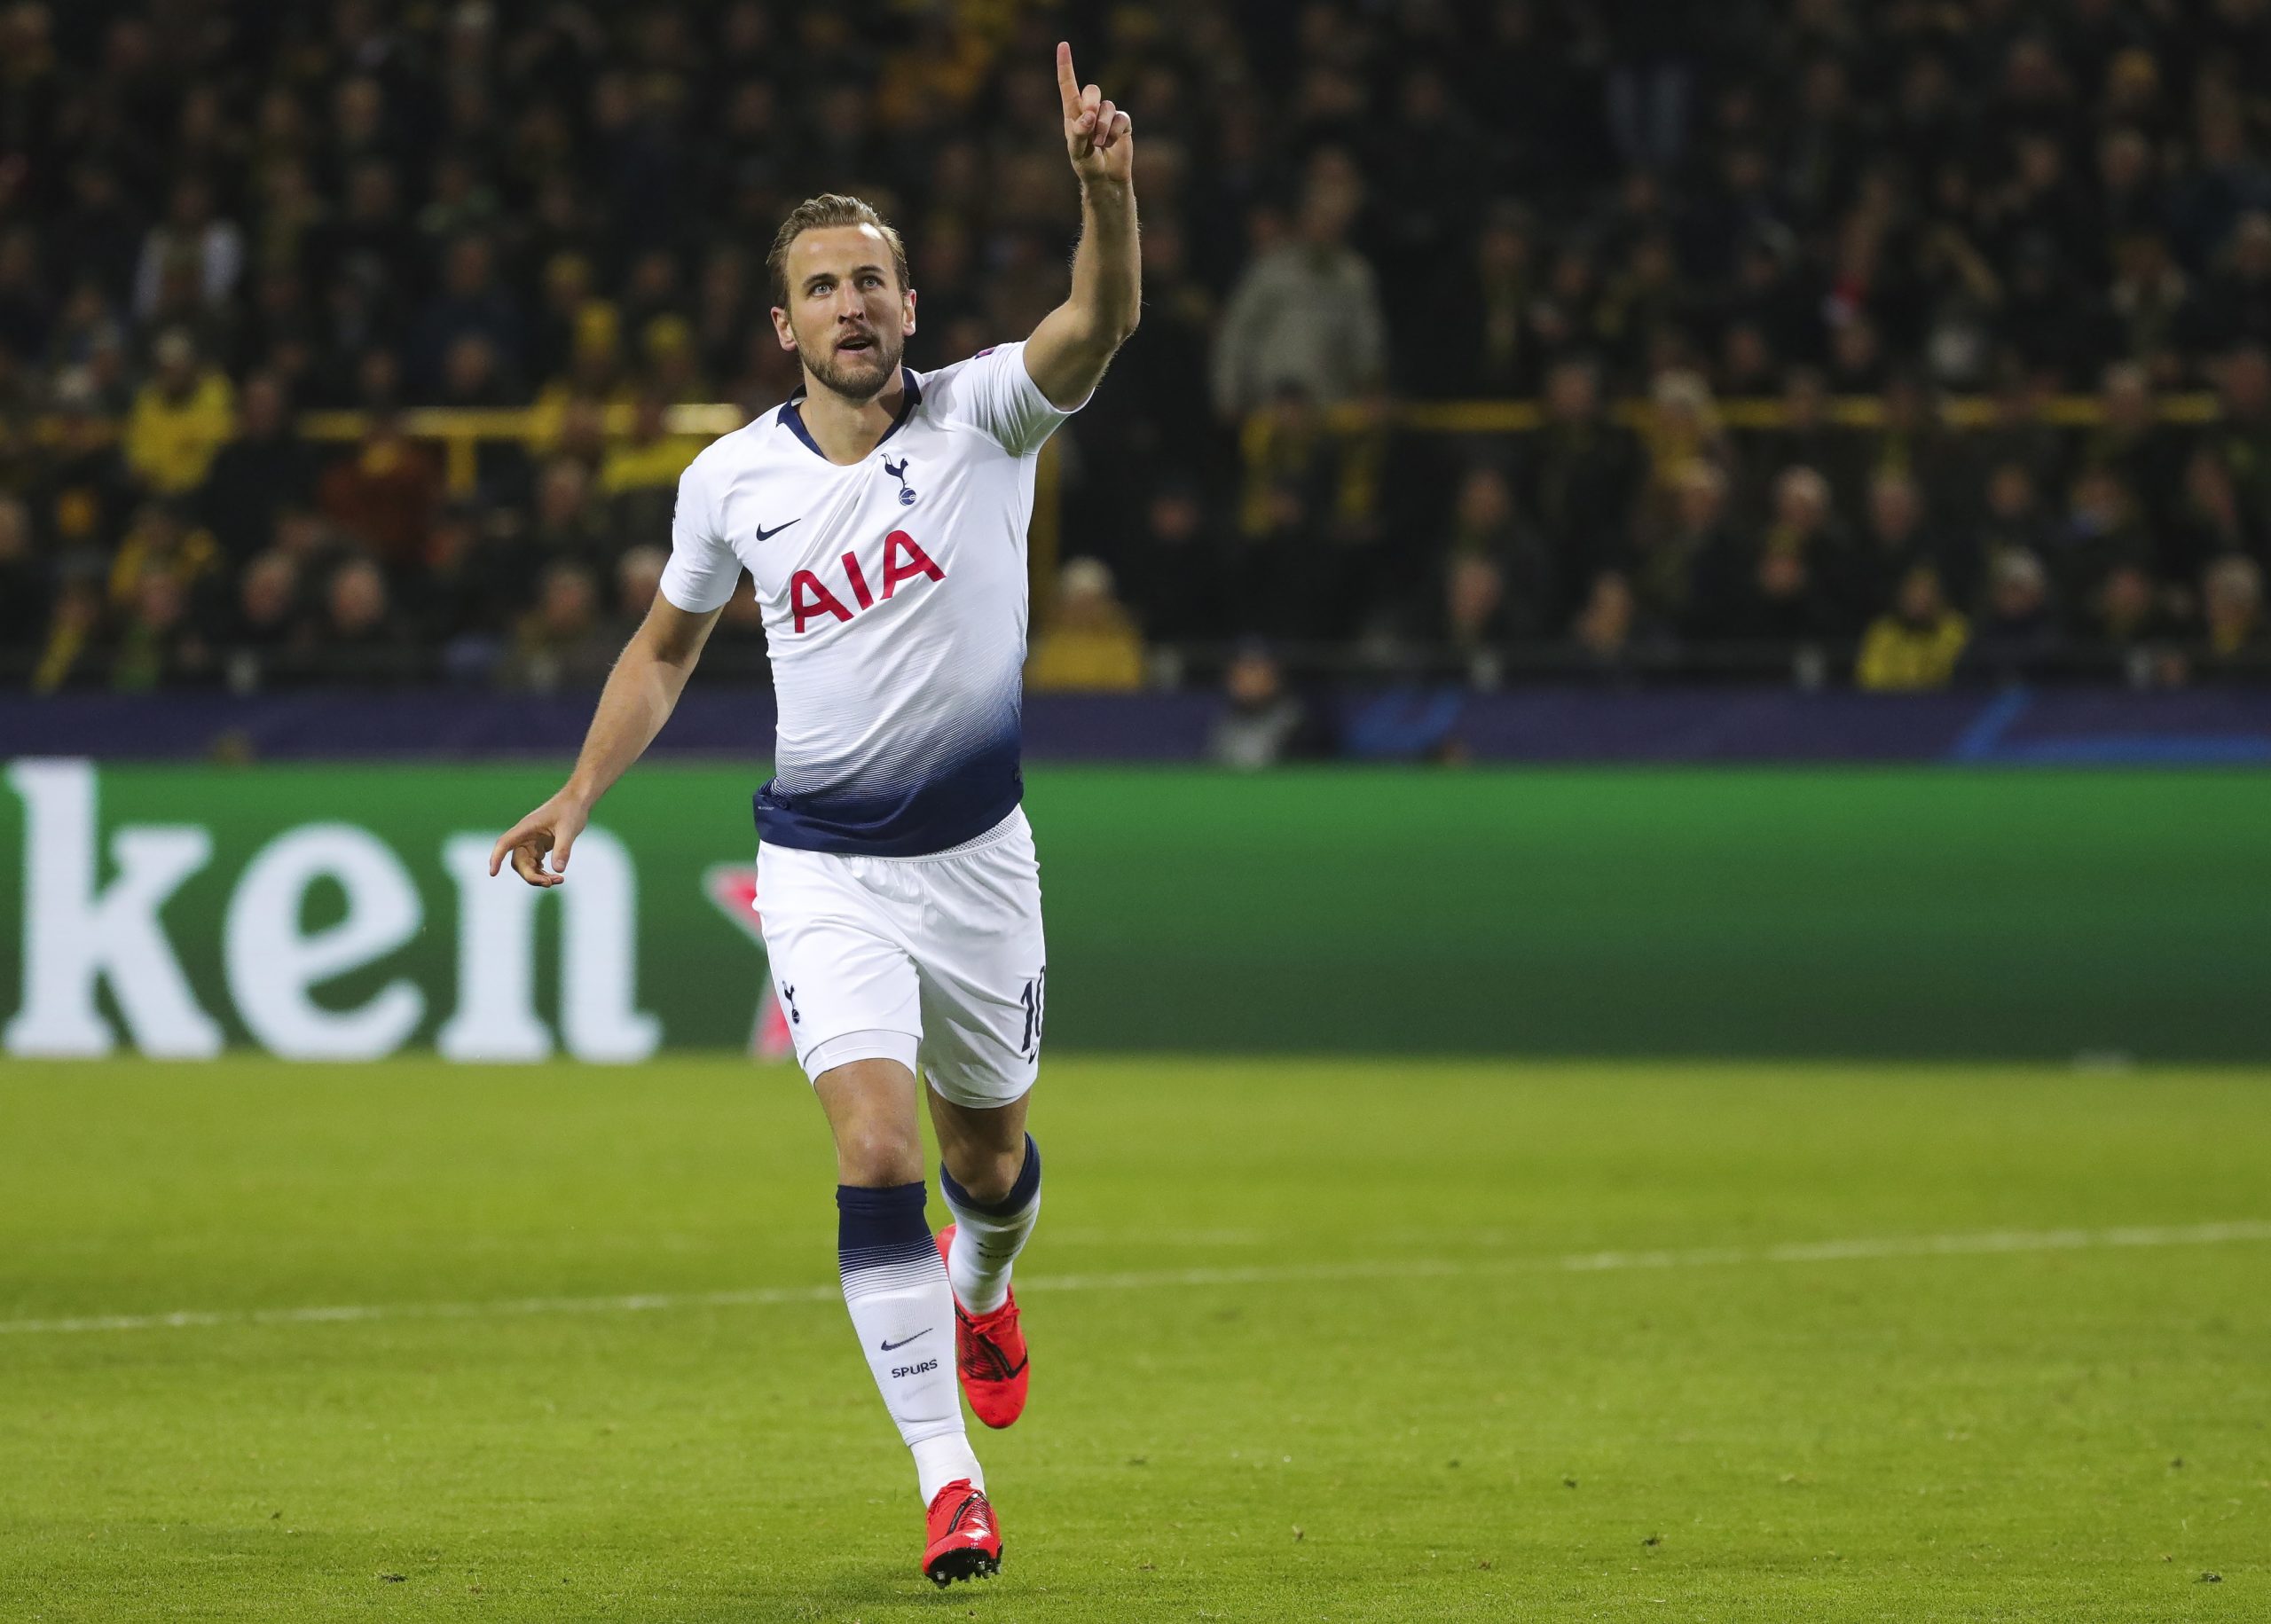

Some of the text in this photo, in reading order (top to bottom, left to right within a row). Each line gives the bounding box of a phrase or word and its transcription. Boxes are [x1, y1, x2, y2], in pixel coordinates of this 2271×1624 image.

[790, 530, 946, 634] AIA
[3, 756, 662, 1063] ken
[891, 1359, 939, 1378] SPURS
